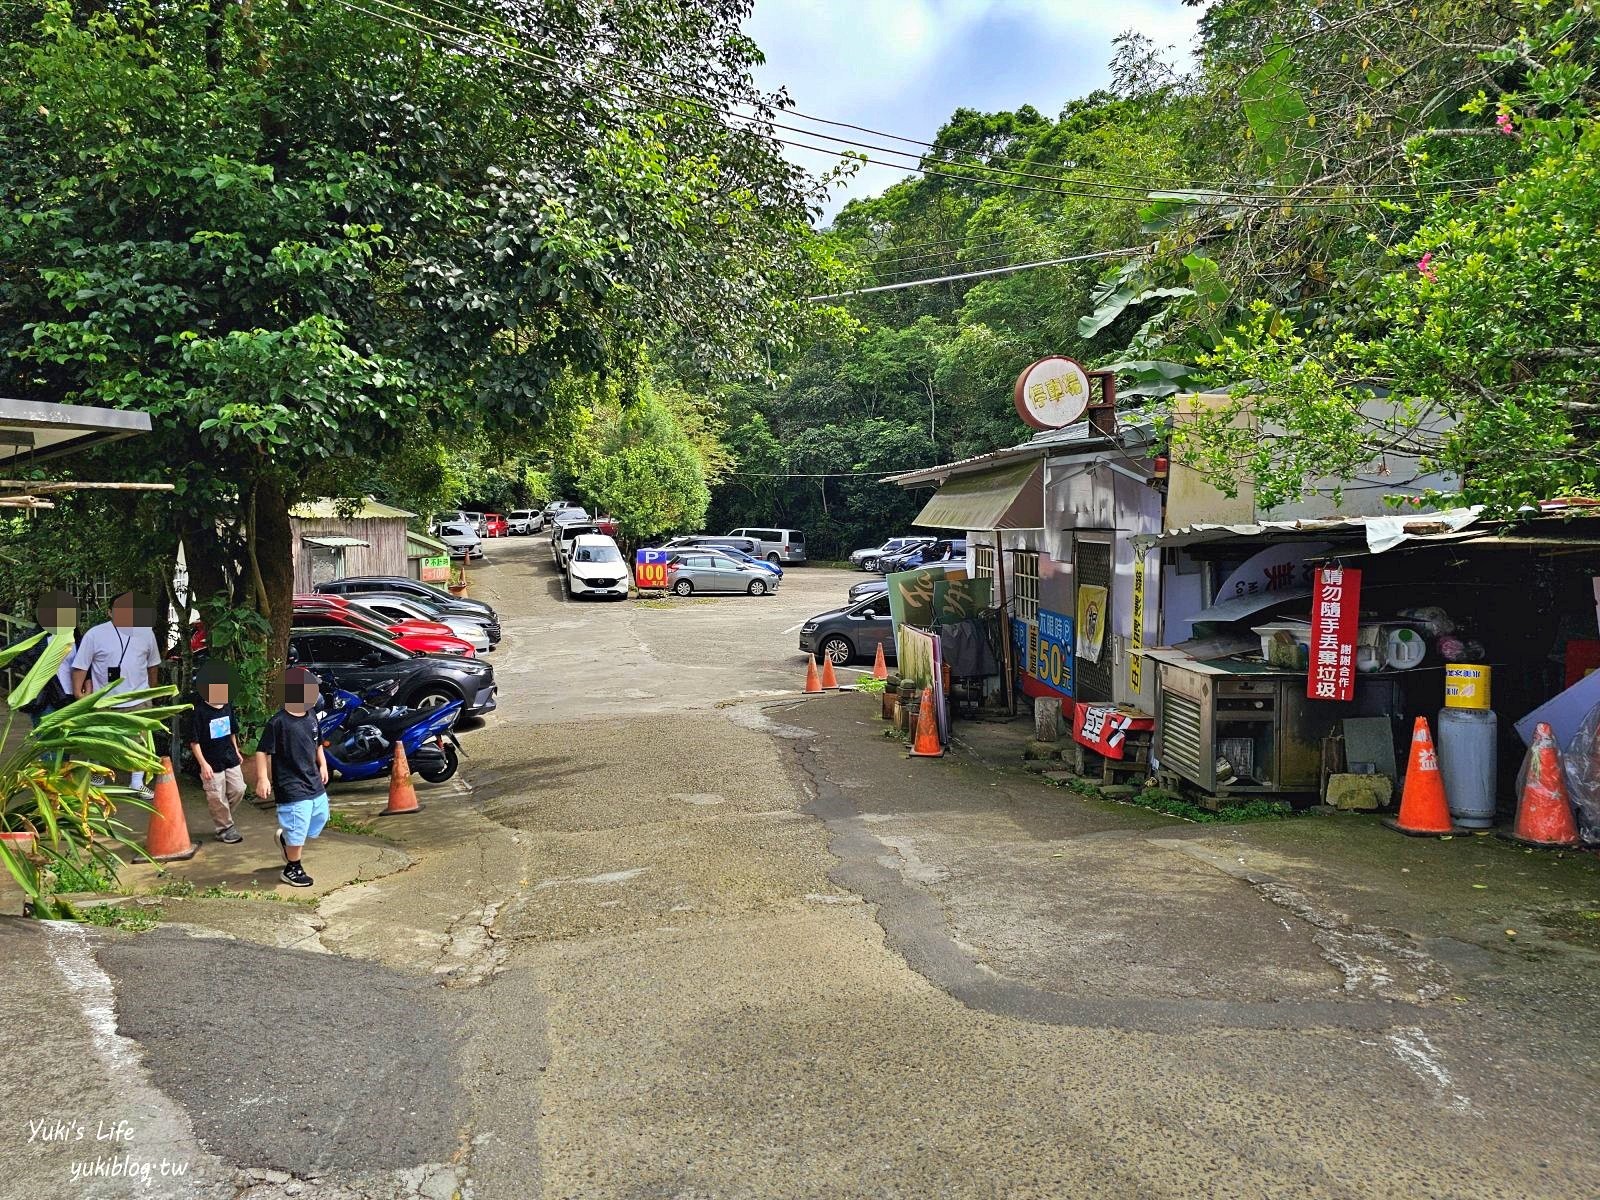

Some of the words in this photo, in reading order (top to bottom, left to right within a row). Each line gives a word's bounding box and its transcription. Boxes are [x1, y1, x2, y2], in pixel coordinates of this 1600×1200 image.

[1029, 371, 1083, 409] 停車場
[645, 551, 659, 564] P
[639, 565, 664, 581] 100
[1316, 569, 1343, 698] 請勿隨手丟棄垃圾
